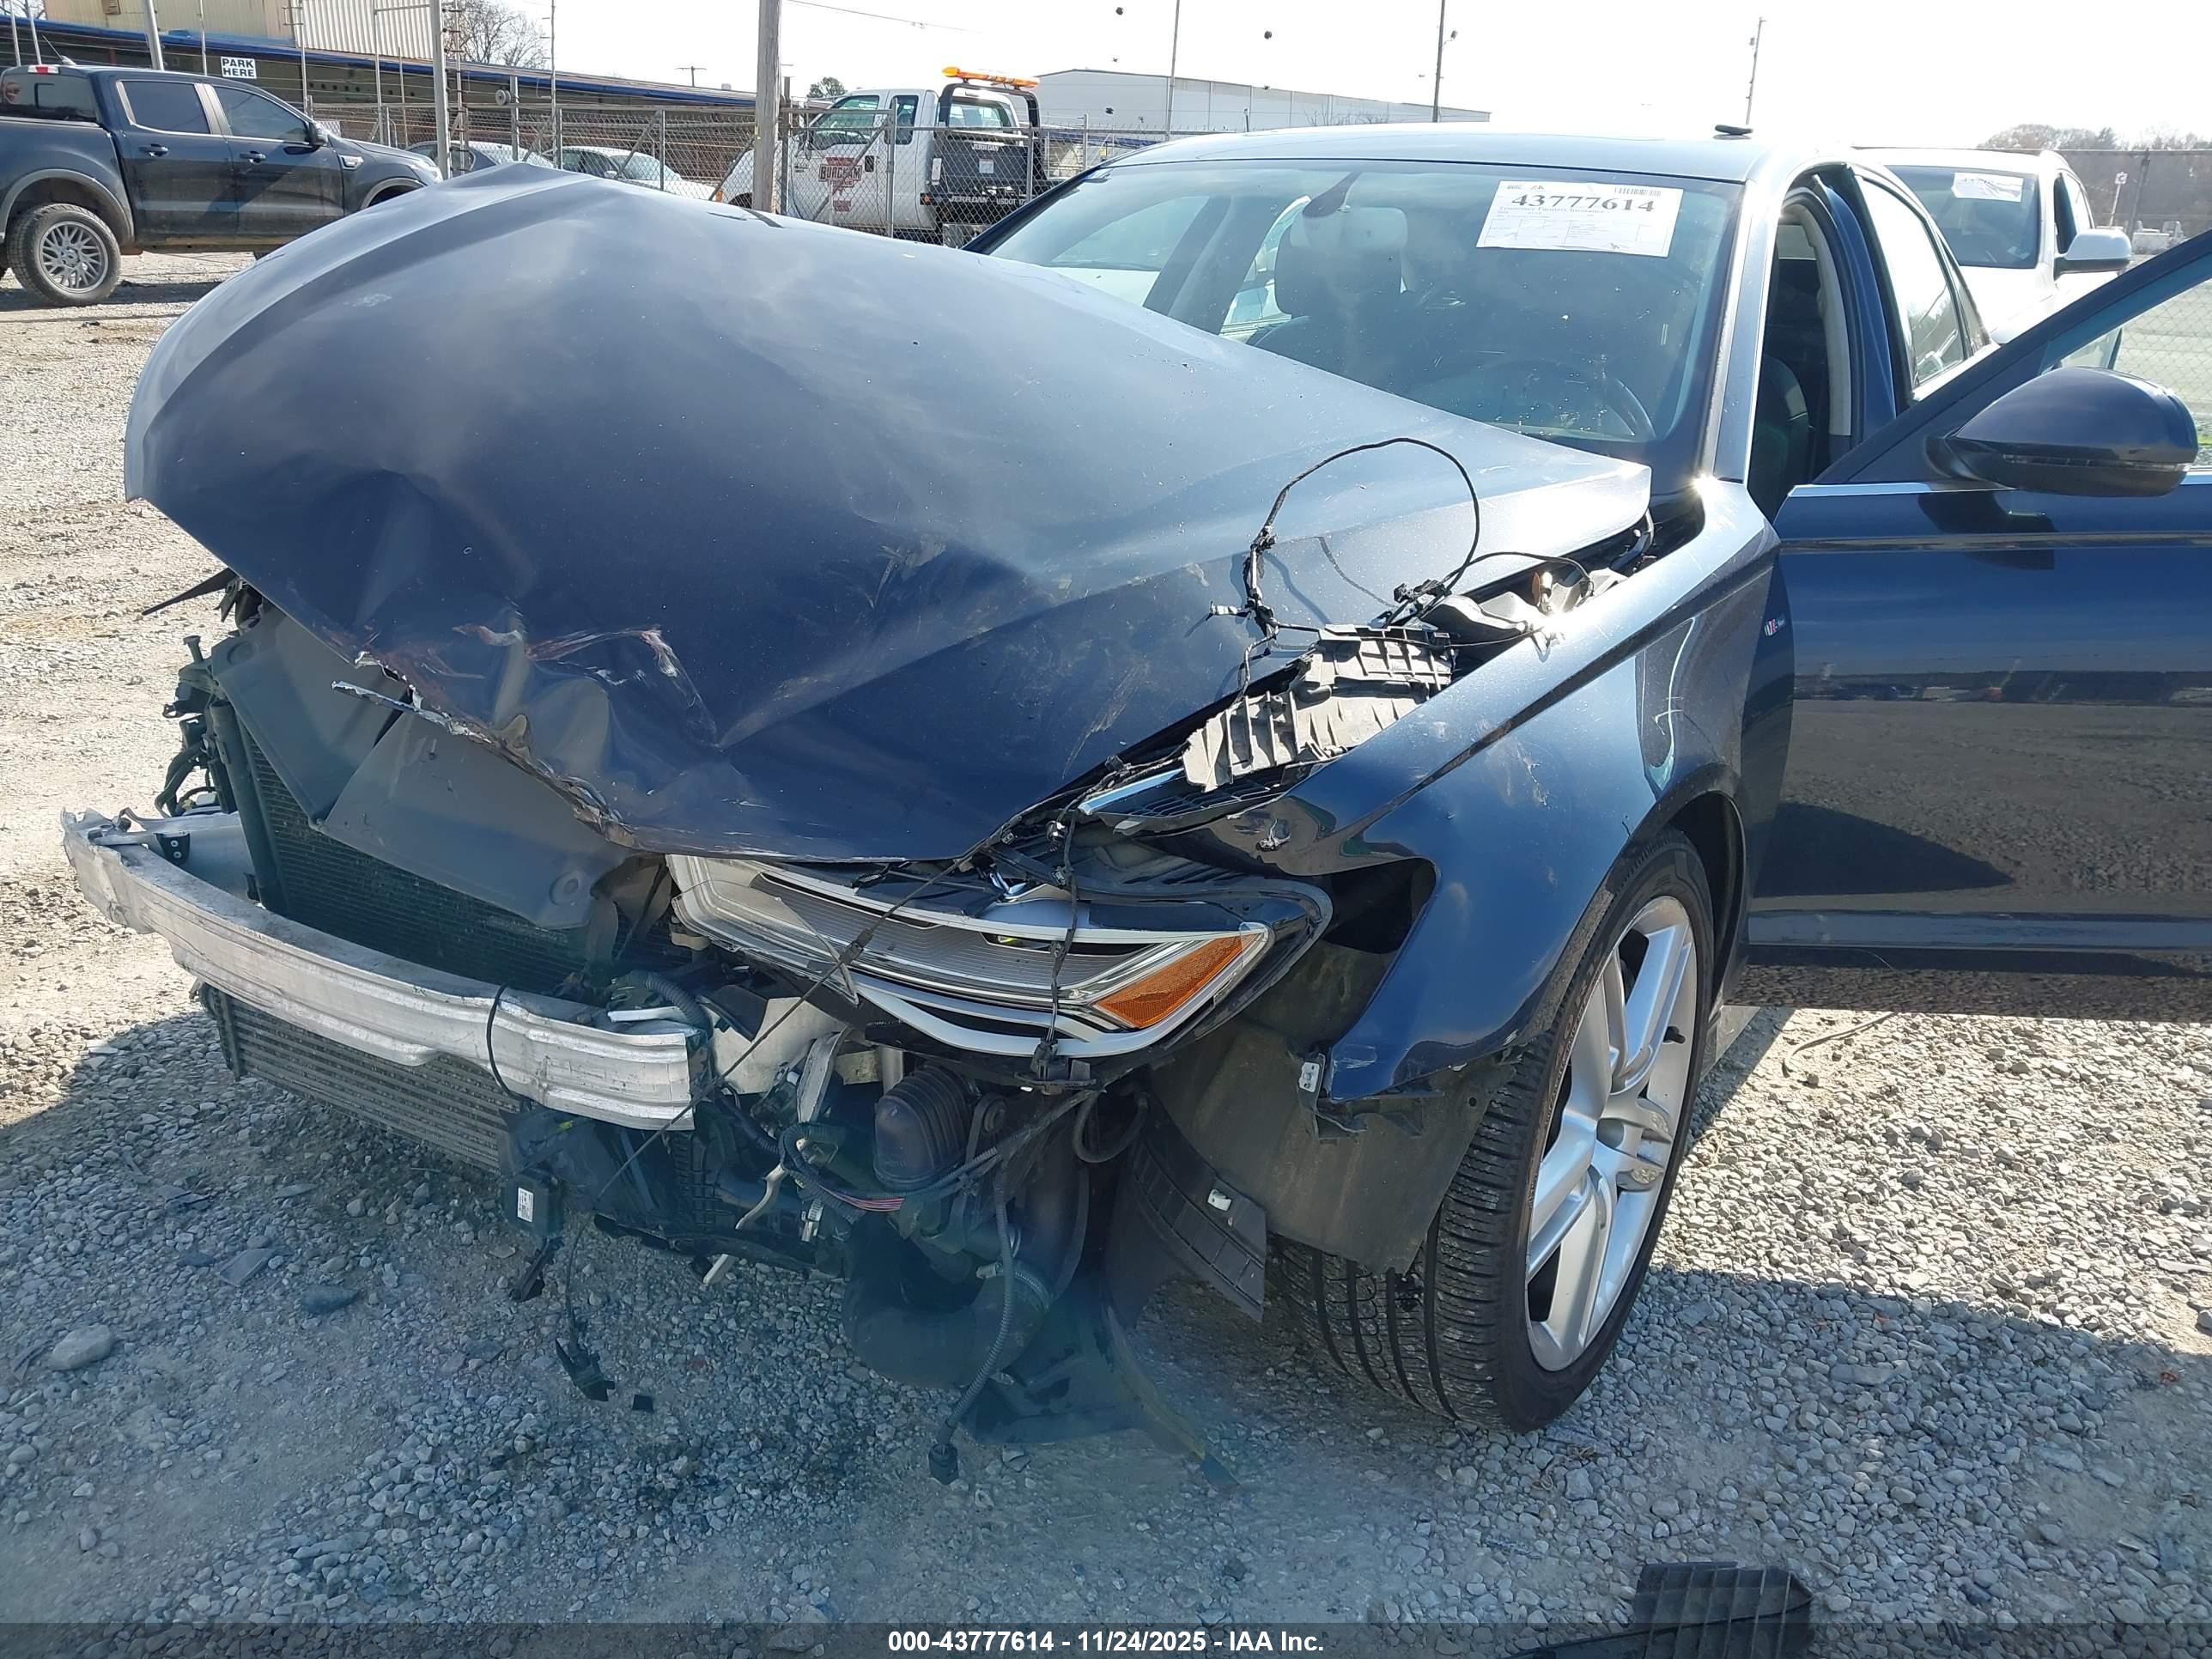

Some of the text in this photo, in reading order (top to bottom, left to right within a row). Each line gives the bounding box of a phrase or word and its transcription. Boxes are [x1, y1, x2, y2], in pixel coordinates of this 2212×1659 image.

[222, 58, 253, 68] PARK
[222, 68, 255, 77] HERE
[1511, 193, 1655, 212] 43777614
